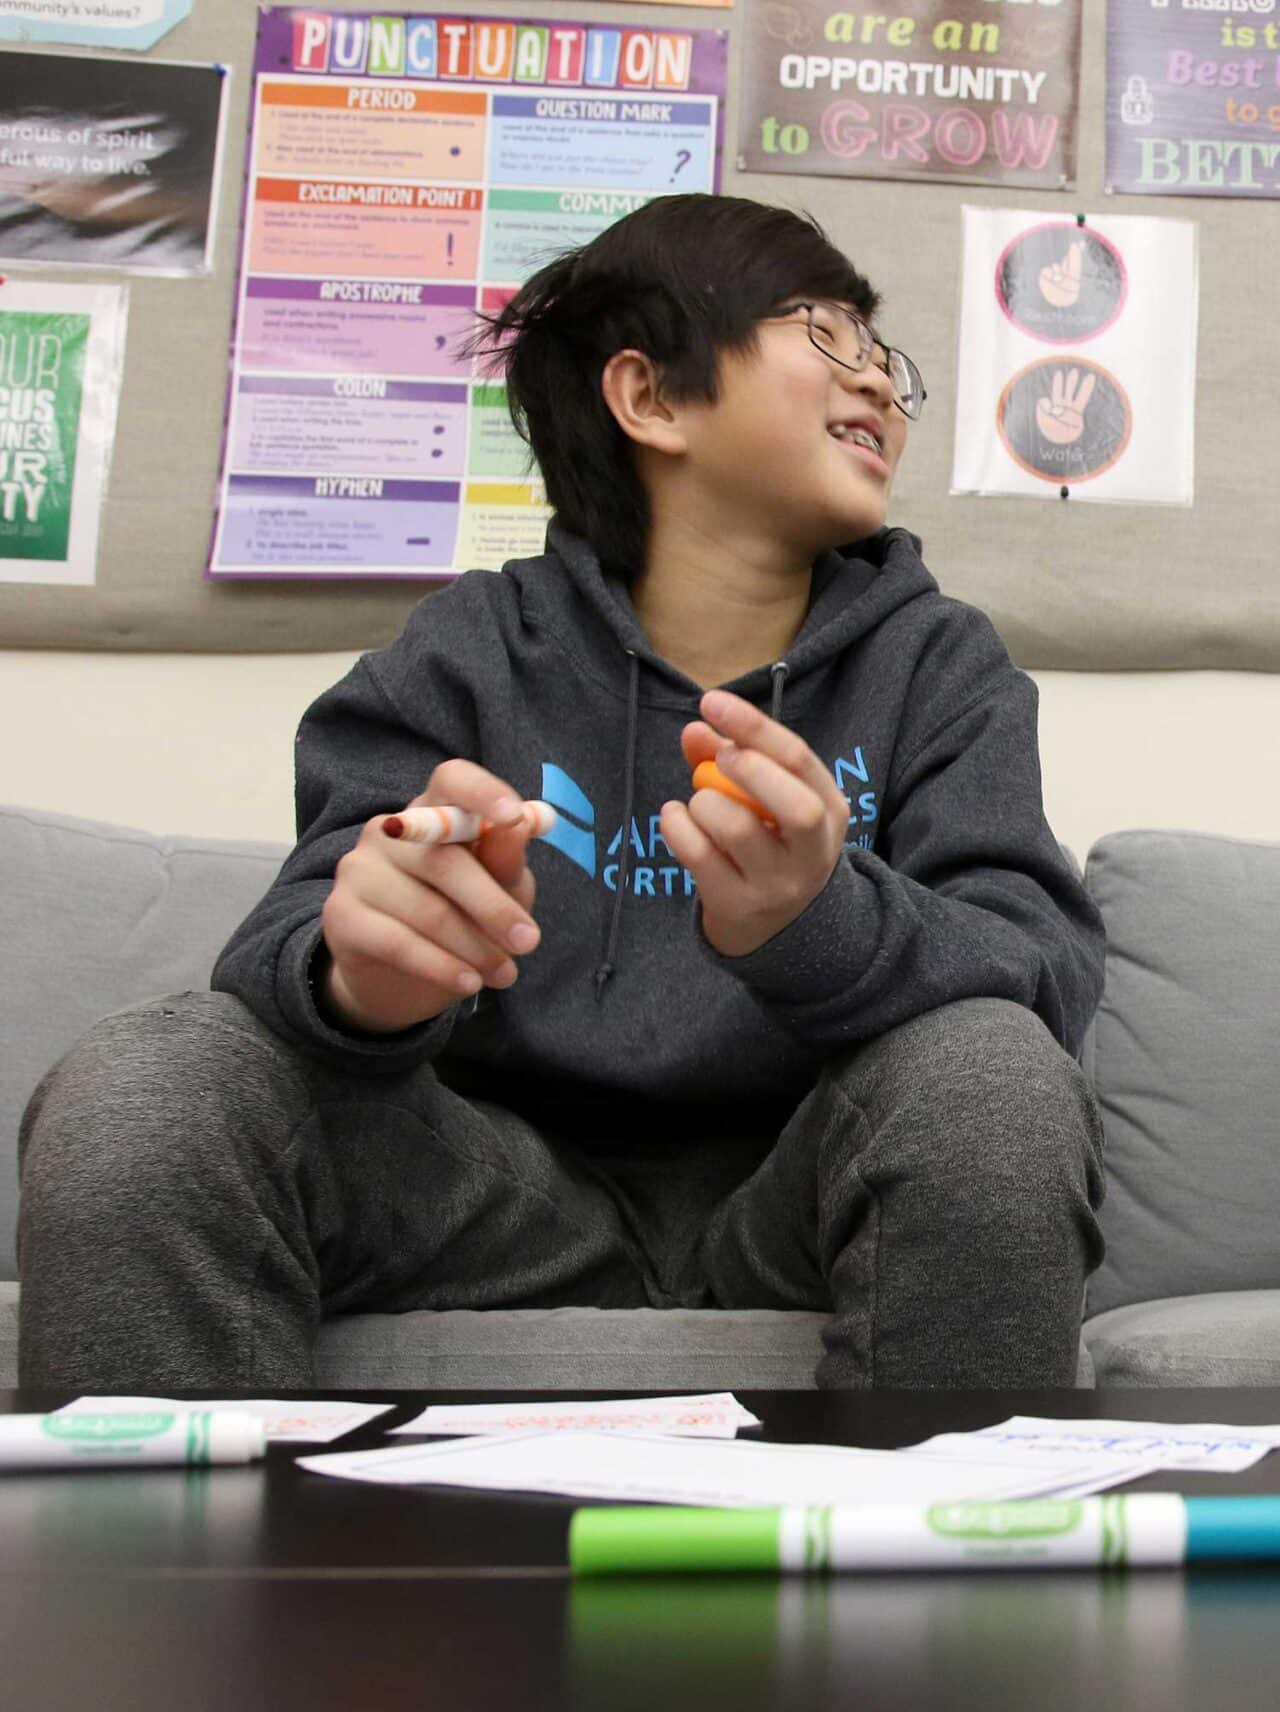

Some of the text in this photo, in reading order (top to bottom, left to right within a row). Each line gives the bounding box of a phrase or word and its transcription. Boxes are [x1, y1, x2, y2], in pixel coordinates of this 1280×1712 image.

[0, 1, 141, 19] mmunity's values?
[824, 11, 1000, 53] are an
[1222, 18, 1255, 47] is
[301, 19, 688, 86] PUNCTUATION
[780, 54, 1046, 104] OPPORTUNITY
[1166, 49, 1264, 87] Best
[348, 88, 417, 109] PERIOD
[536, 100, 673, 121] QUESTION MARK
[1225, 100, 1259, 122] to
[67, 127, 93, 145] of
[96, 130, 155, 152] spirit
[761, 99, 1058, 169] to GROW
[35, 154, 79, 175] way
[82, 155, 104, 171] to
[109, 156, 152, 175] live.
[299, 183, 413, 206] EXCLAMATION
[417, 188, 465, 208] POINT
[320, 282, 423, 304] APOSTROPHE
[0, 333, 62, 389] UR
[334, 378, 387, 398] COLON
[1040, 447, 1087, 463] Water
[315, 478, 384, 497] HYPHEN
